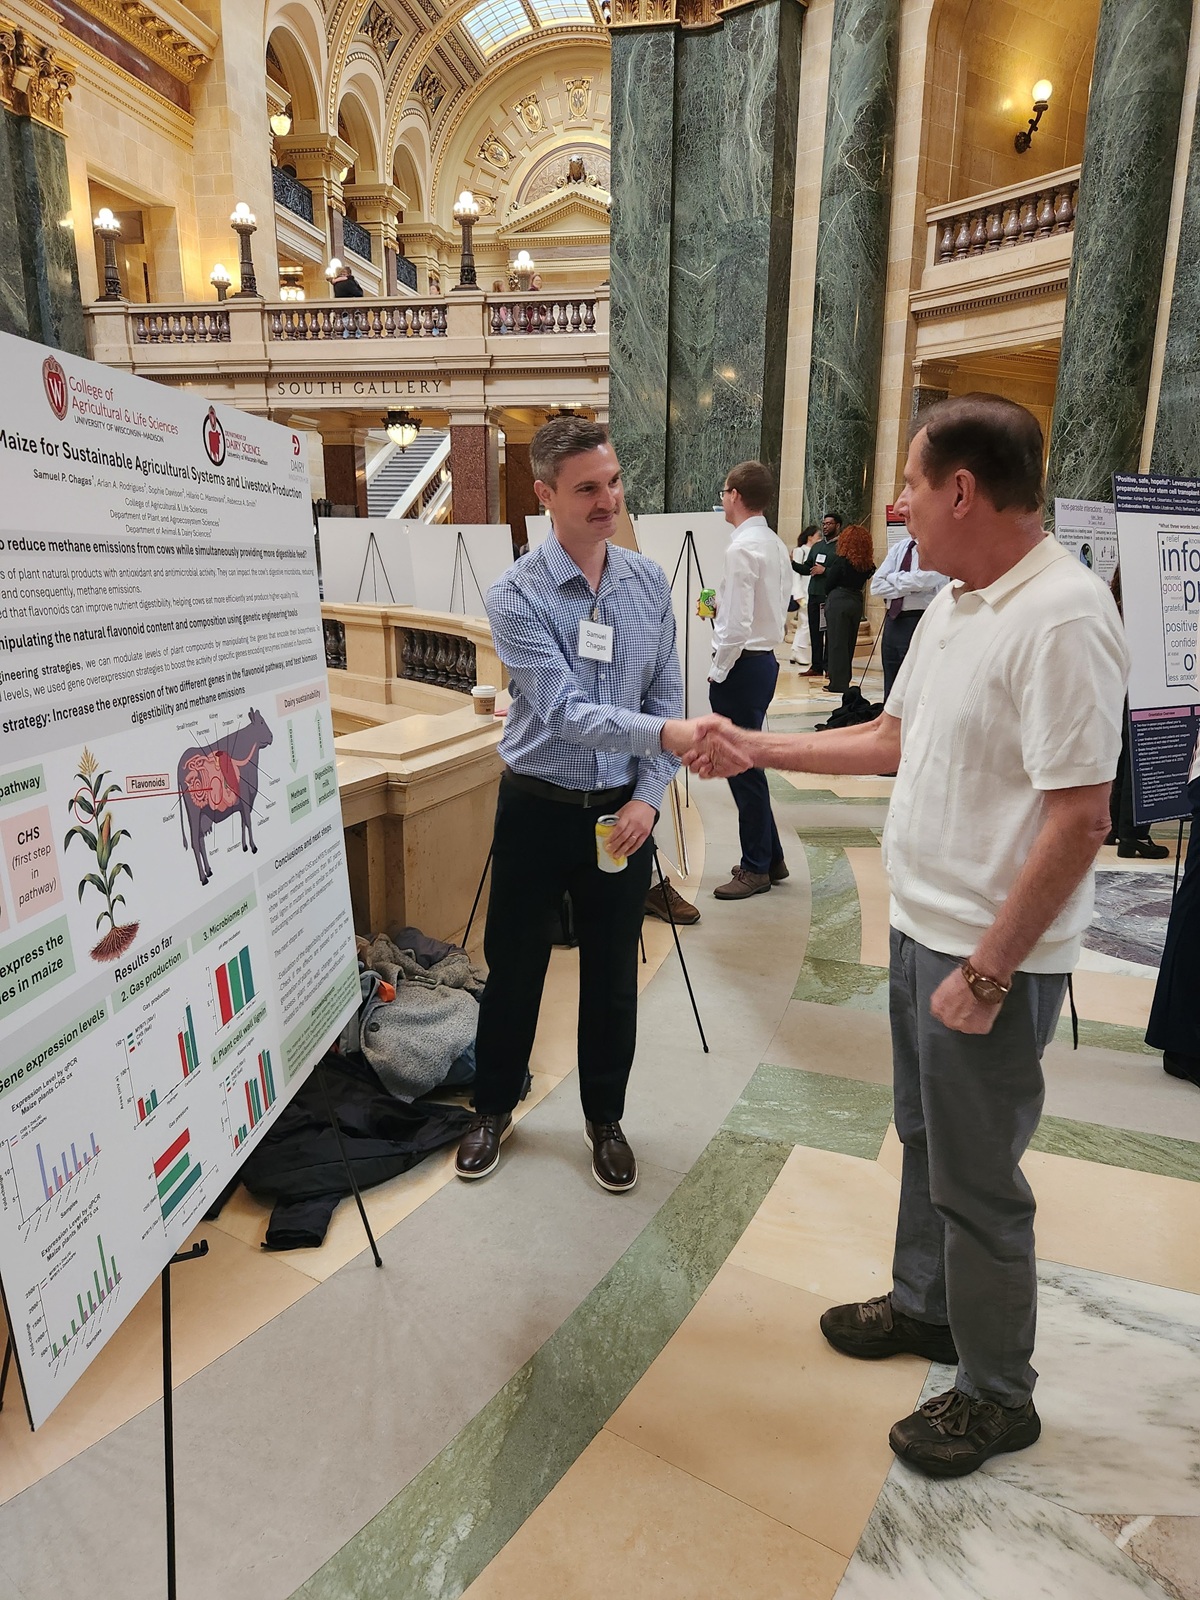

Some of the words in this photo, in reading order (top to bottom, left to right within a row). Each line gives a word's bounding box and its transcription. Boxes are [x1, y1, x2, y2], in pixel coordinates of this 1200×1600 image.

[49, 378, 62, 410] W
[69, 376, 102, 400] College
[105, 388, 114, 400] of
[278, 382, 342, 395] SOUTH
[354, 380, 442, 394] GALLERY
[72, 396, 122, 420] Agricultural
[125, 410, 131, 423] &
[133, 412, 146, 426] Life
[148, 416, 178, 435] Sciences
[74, 416, 106, 429] UNIVERSITY
[114, 425, 164, 442] WISCONSIN-MADISON
[226, 439, 242, 452] DAIRY
[242, 442, 262, 457] SCIENCE
[33, 469, 60, 482] Samuel
[40, 437, 60, 457] for
[62, 441, 132, 470] Sustainable
[135, 456, 190, 480] Agricultural
[191, 466, 226, 486] Systems
[227, 475, 240, 488] and
[241, 477, 272, 494] Livestock
[272, 482, 303, 500] Production
[1172, 480, 1196, 488] Leveraging
[110, 510, 140, 520] Department
[124, 498, 144, 509] College
[150, 500, 176, 512] Agricultural
[126, 524, 155, 535] Department
[1166, 535, 1180, 543] relief
[7, 537, 46, 552] reduce
[48, 539, 91, 553] methane
[93, 541, 136, 554] emissions
[136, 542, 156, 554] from
[156, 544, 175, 555] cows
[176, 544, 194, 556] while
[195, 544, 239, 558] simultaneously
[240, 547, 263, 560] providing
[8, 568, 16, 580] of
[19, 568, 40, 582] plant
[42, 568, 70, 579] natural
[72, 568, 102, 580] products
[104, 568, 118, 578] with
[119, 568, 152, 578] antioxidant
[152, 568, 164, 577] and
[2, 588, 18, 600] and
[20, 586, 76, 600] consequently,
[76, 584, 107, 596] methane
[108, 584, 142, 594] emissions.
[1162, 582, 1182, 594] good
[10, 606, 28, 619] that
[28, 604, 70, 617] flavonoids
[70, 604, 84, 614] can
[86, 602, 113, 614] improve
[114, 600, 138, 610] nutrient
[172, 597, 192, 608] helping
[1164, 603, 1184, 612] grateful
[0, 634, 54, 652] nipulating
[54, 630, 72, 644] the
[74, 626, 106, 642] natural
[107, 622, 145, 638] flavonoid
[146, 620, 174, 634] content
[175, 618, 188, 630] and
[189, 614, 226, 629] composition
[227, 614, 242, 626] using
[242, 612, 261, 625] genetic
[586, 630, 607, 640] Samuel
[1166, 620, 1198, 635] positive
[586, 640, 606, 652] Chagas
[42, 661, 84, 676] strategies,
[85, 658, 96, 668] we
[98, 656, 111, 666] can
[113, 650, 143, 665] modulate
[144, 648, 162, 659] levels
[170, 646, 184, 656] plant
[186, 640, 214, 654] compounds
[4, 688, 32, 702] levels,
[32, 685, 46, 696] we
[46, 680, 66, 694] used
[68, 677, 86, 692] gene
[86, 668, 136, 686] overexpression
[136, 664, 164, 677] strategies
[171, 659, 186, 670] boost
[1168, 674, 1179, 682] less
[2, 714, 52, 733] strategy:
[52, 702, 95, 722] Increase
[96, 698, 111, 712] the
[112, 689, 156, 708] expression
[156, 686, 164, 697] of
[165, 683, 178, 694] two
[180, 678, 207, 694] different
[208, 674, 226, 688] genes
[241, 664, 265, 680] flavonoid
[131, 702, 174, 724] digestibility
[175, 698, 188, 712] and
[189, 692, 217, 708] methane
[218, 686, 246, 702] emissions
[284, 697, 296, 708] Dairy
[296, 689, 320, 704] sustainability
[131, 778, 166, 790] Flavonoids
[290, 786, 307, 800] Methane
[17, 826, 40, 845] CHS
[12, 852, 32, 871] (first
[33, 844, 52, 860] step
[274, 845, 304, 870] Conclusions
[31, 868, 39, 880] in
[18, 877, 57, 908] pathway)
[208, 909, 240, 937] Microbiome
[0, 944, 45, 979] express
[46, 934, 64, 952] the
[114, 952, 149, 983] Results
[150, 944, 160, 958] so
[161, 935, 174, 949] far
[18, 978, 30, 993] in
[32, 957, 64, 985] maize
[120, 991, 128, 1003] 2.
[130, 980, 144, 995] Gas
[146, 952, 182, 987] production
[26, 1031, 78, 1072] expression
[79, 1008, 106, 1034] levels
[218, 1042, 233, 1060] Plant
[232, 1031, 242, 1045] cell
[11, 1086, 43, 1112] Expression
[42, 1072, 58, 1090] Level
[57, 1068, 64, 1078] by
[21, 1098, 38, 1116] Maize
[38, 1088, 54, 1104] plants
[54, 1078, 66, 1090] CHS
